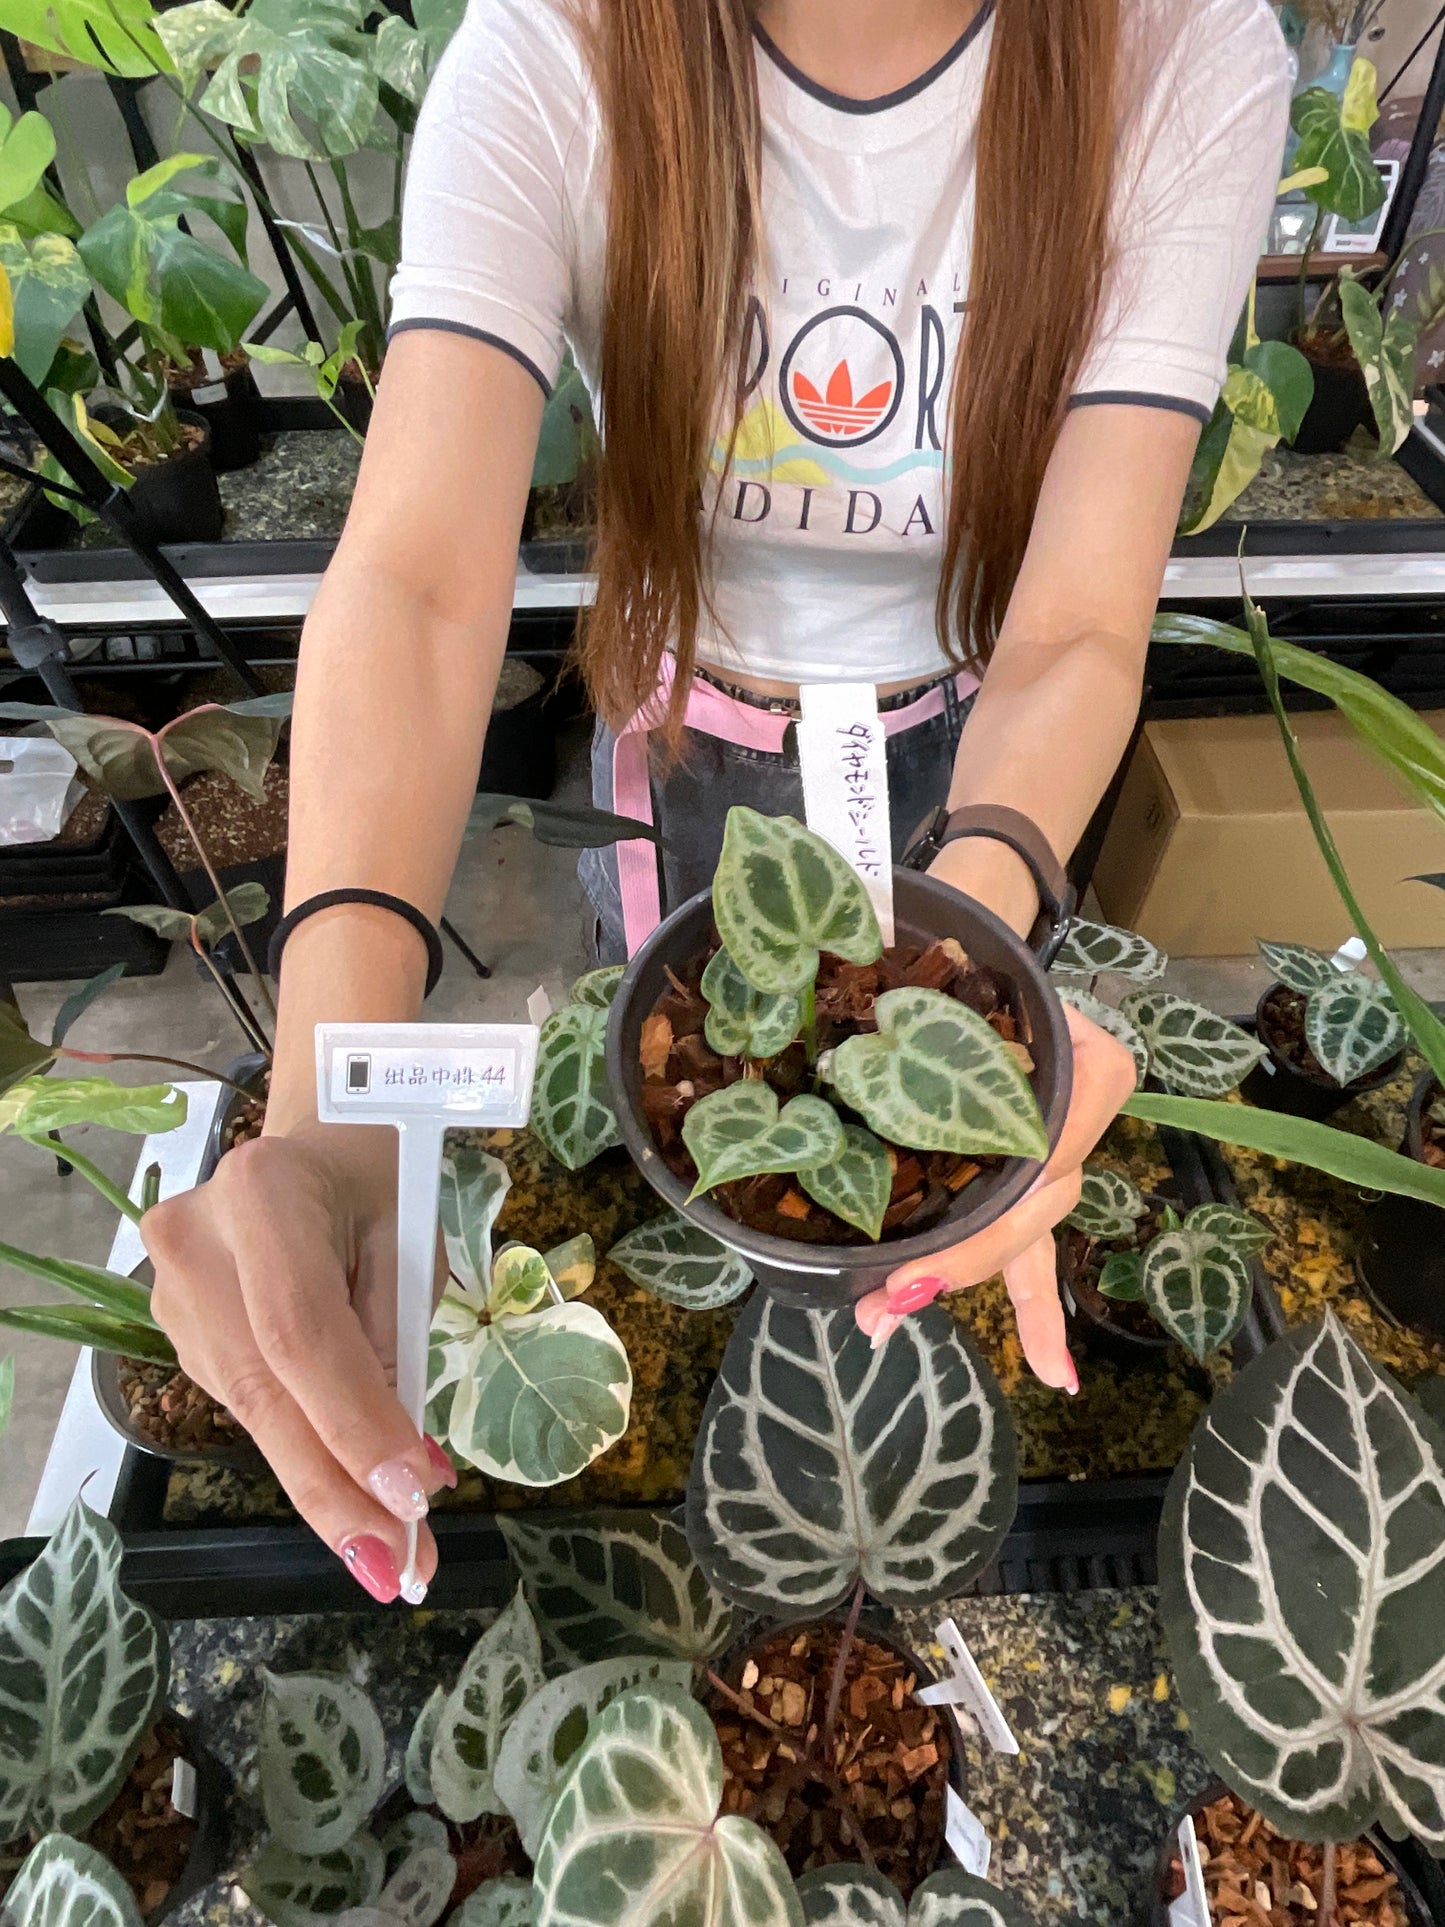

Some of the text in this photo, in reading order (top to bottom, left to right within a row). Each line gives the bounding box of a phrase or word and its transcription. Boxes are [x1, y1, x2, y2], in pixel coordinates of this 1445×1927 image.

[782, 272, 962, 307] IGINAL
[733, 295, 967, 451] POR
[697, 480, 936, 536] DIDA
